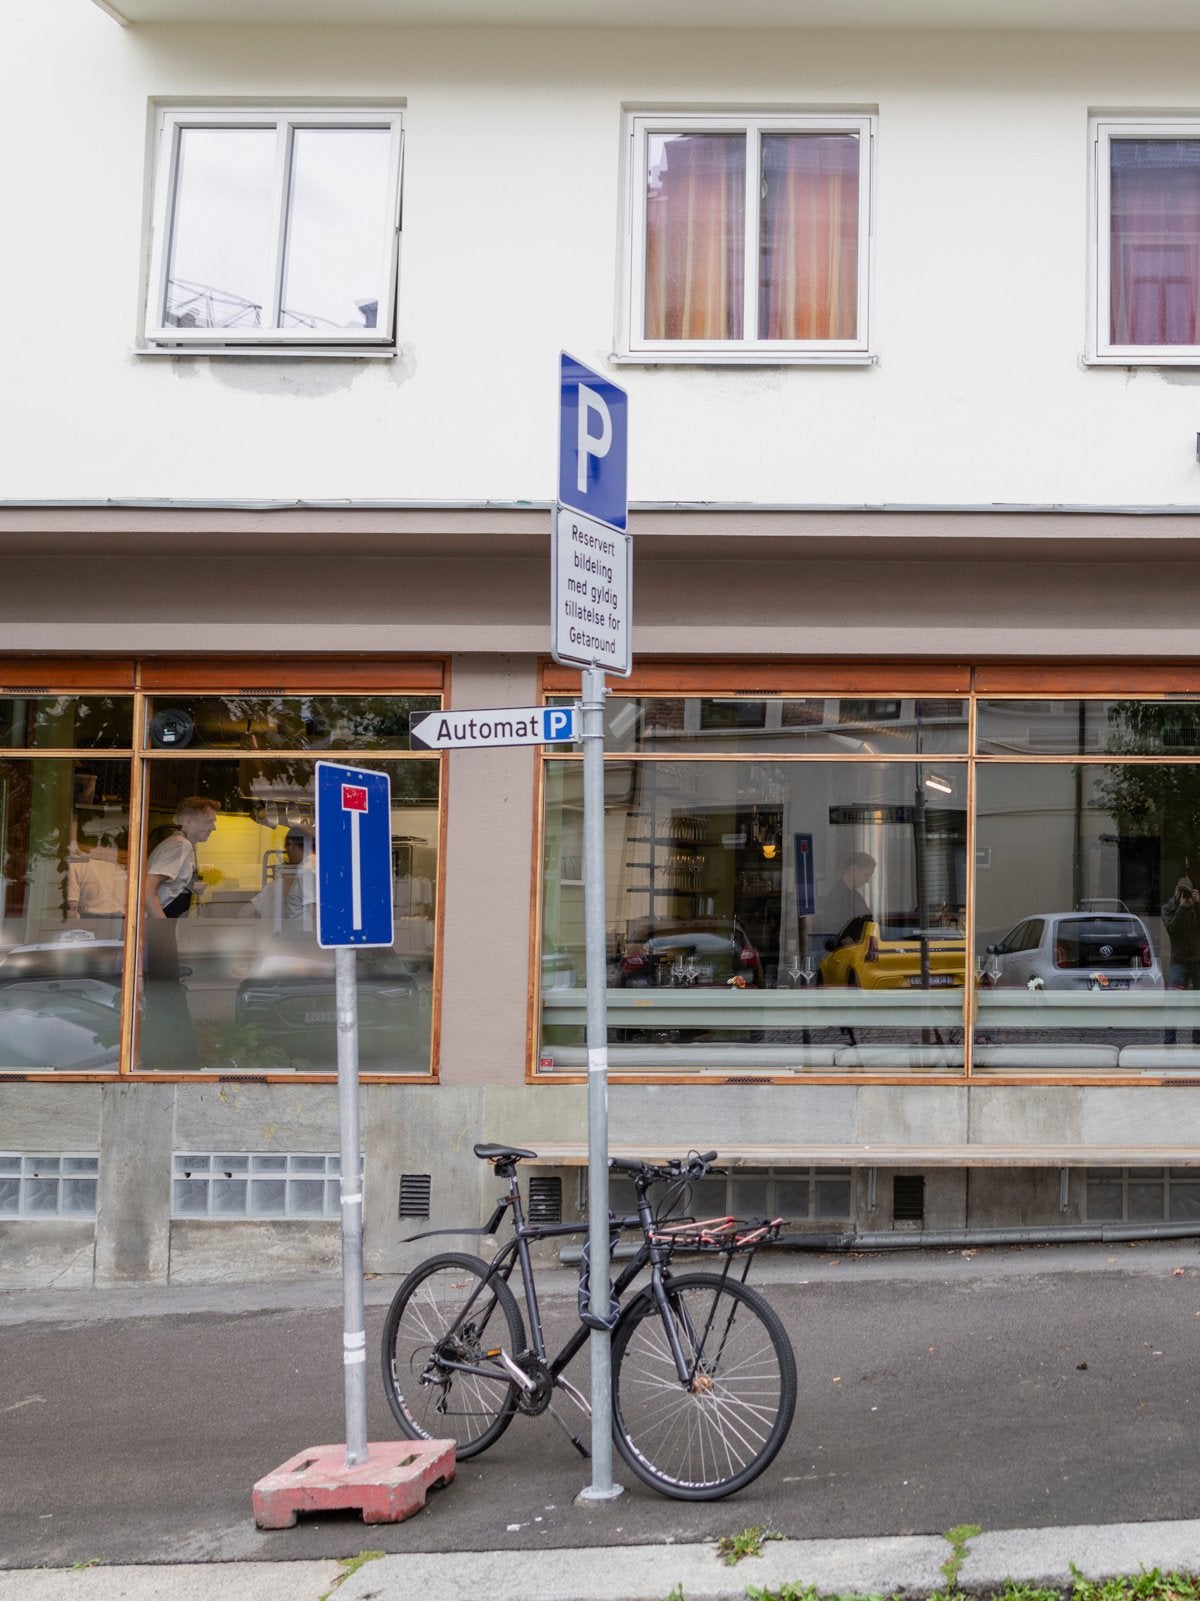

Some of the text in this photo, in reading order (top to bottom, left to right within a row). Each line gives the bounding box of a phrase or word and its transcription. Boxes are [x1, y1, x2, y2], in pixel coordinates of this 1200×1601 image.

[577, 382, 613, 494] P
[572, 524, 615, 557] Reservert
[574, 551, 612, 583] bildeling
[567, 578, 618, 609] med gyldig
[564, 600, 620, 631] tillatelse for
[569, 626, 616, 654] Getaround
[436, 711, 568, 741] Automat P
